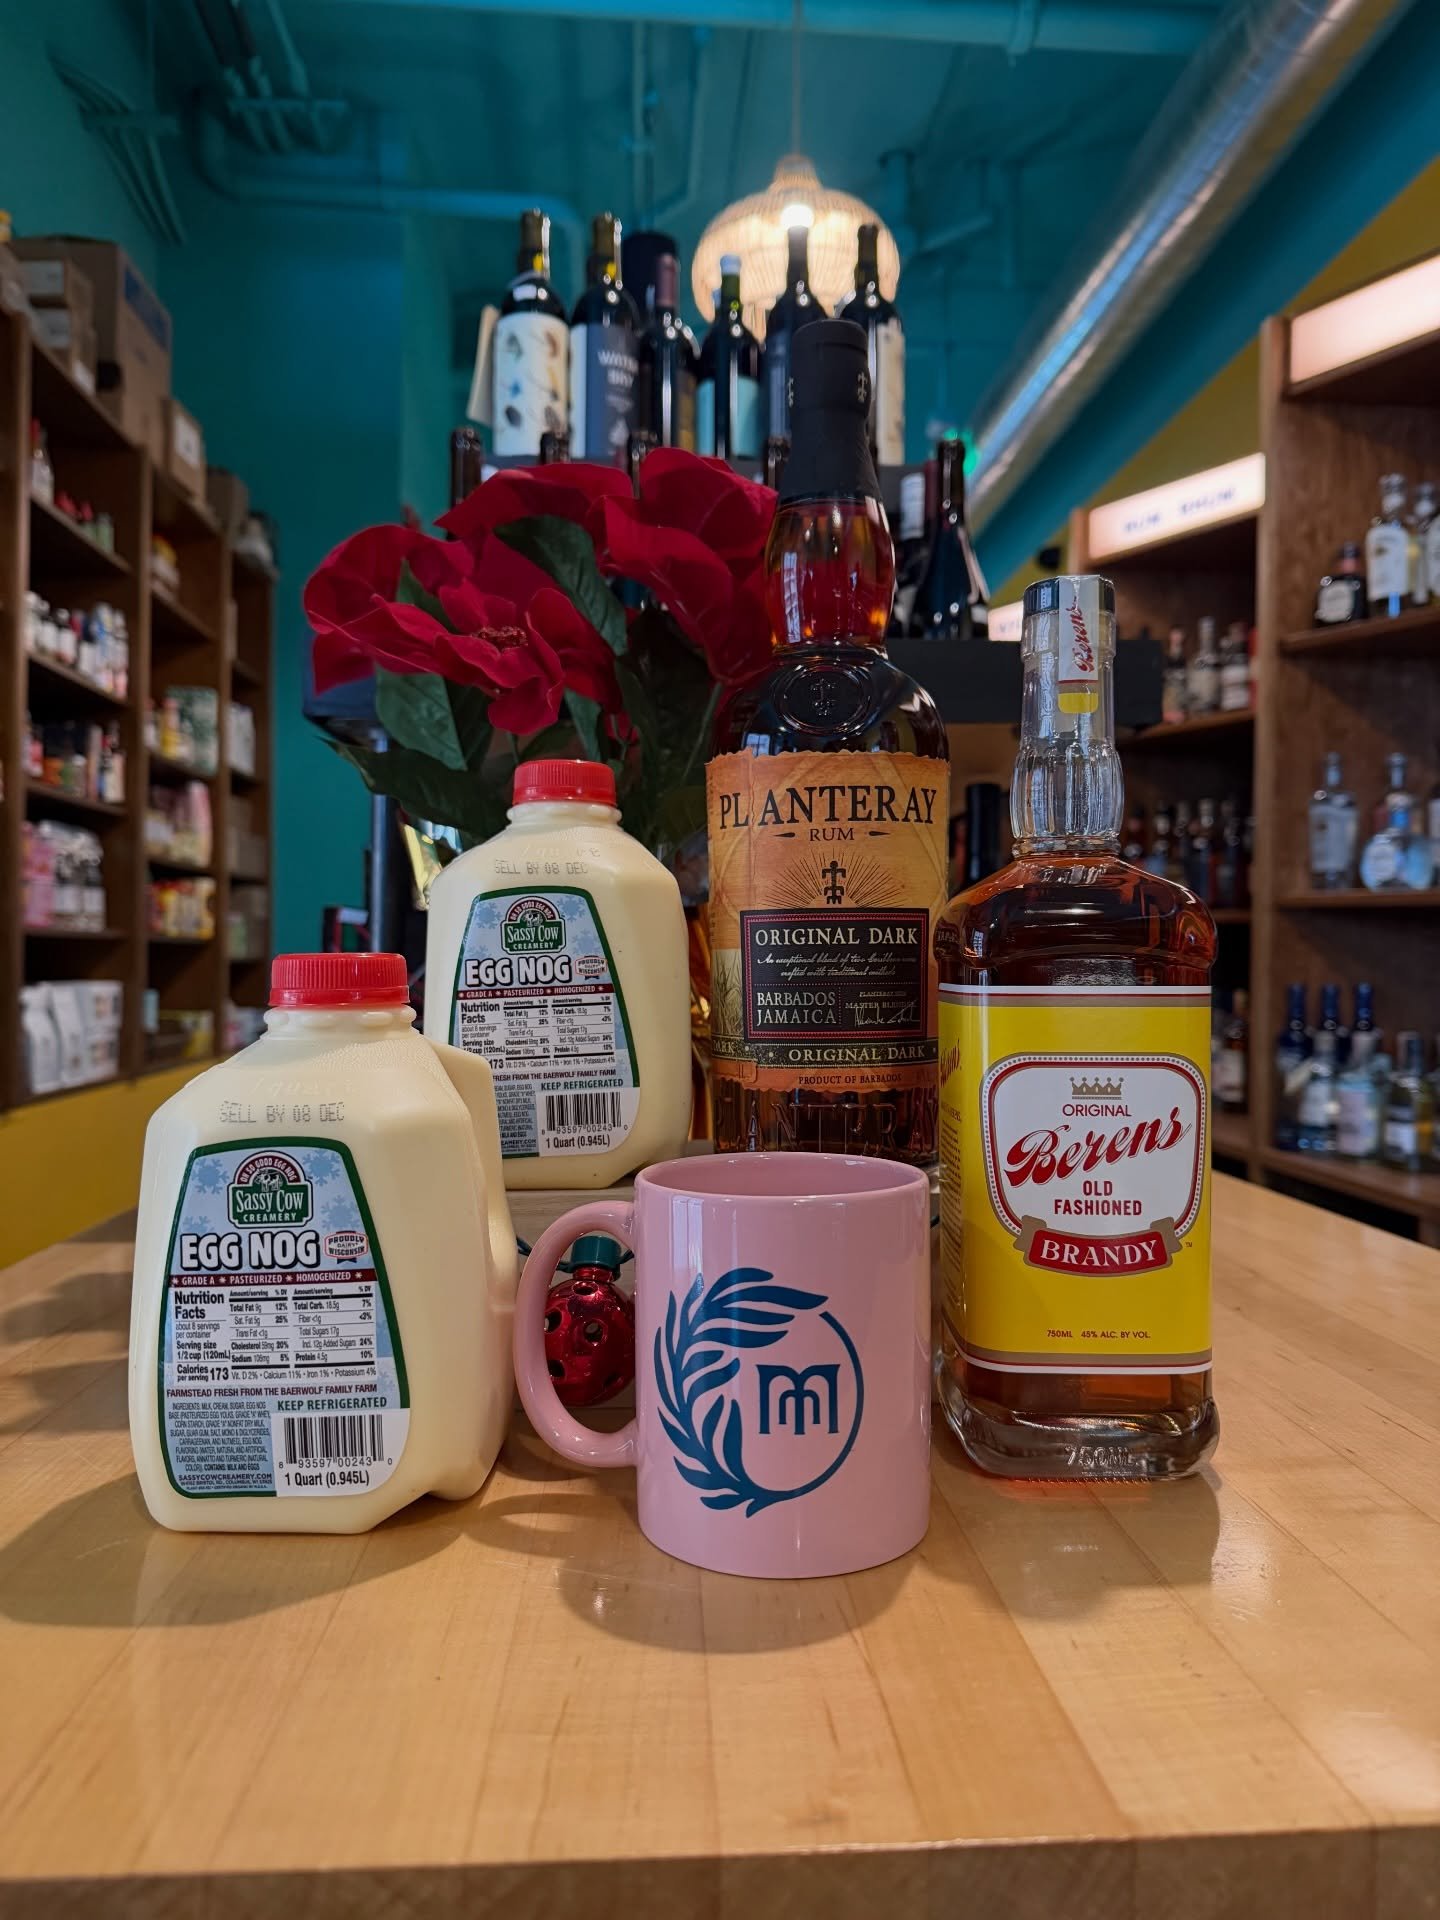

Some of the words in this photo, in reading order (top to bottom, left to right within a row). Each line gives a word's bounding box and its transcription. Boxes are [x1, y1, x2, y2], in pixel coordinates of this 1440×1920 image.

[720, 786, 937, 830] PLANTERAY
[810, 828, 854, 841] RUM
[527, 862, 539, 874] BY
[545, 862, 560, 874] 08
[566, 862, 588, 874] DEC
[507, 926, 535, 943] Sassy
[538, 925, 559, 941] Cow
[755, 928, 859, 945] ORIGINAL
[869, 927, 918, 944] DARK
[513, 942, 553, 950] CREAMERY
[466, 959, 512, 986] EGG
[518, 956, 571, 984] NOG
[554, 986, 595, 994] HOMOGENIZED
[757, 992, 836, 1006] BARBADOS
[461, 1002, 500, 1012] Nutrition
[462, 1014, 486, 1024] Facts
[757, 1009, 836, 1026] JAMAICA
[789, 1047, 881, 1062] ORIGINAL
[888, 1046, 924, 1059] DARK
[541, 1082, 561, 1091] KEEP
[564, 1079, 623, 1090] REFRIGERATED
[799, 1076, 841, 1085] PRODUCT
[845, 1075, 856, 1084] OF
[220, 1101, 256, 1122] SELL
[267, 1105, 285, 1122] BY
[293, 1105, 311, 1122] 08
[320, 1102, 344, 1121] DEC
[1062, 1104, 1132, 1117] ORIGINAL
[557, 1125, 581, 1134] 93597
[587, 1124, 612, 1132] 00243
[546, 1140, 550, 1149] 1
[554, 1137, 575, 1147] Quart
[578, 1134, 610, 1147] (0.945L)
[1004, 1106, 1192, 1188] Berens
[255, 1158, 272, 1167] GOOD
[274, 1159, 287, 1169] EGG
[284, 1166, 297, 1180] NOG
[1083, 1181, 1113, 1196] OLD
[236, 1190, 272, 1212] Sassy
[276, 1190, 304, 1212] Cow
[1054, 1200, 1142, 1216] FASHIONED
[243, 1213, 296, 1222] CREAMERY
[328, 1235, 364, 1244] PROUDLY
[181, 1234, 240, 1270] EGG
[250, 1231, 319, 1268] NOG
[329, 1246, 364, 1255] WISCONSIN
[1040, 1239, 1157, 1267] BRANDY
[182, 1277, 207, 1285] GRADE
[230, 1275, 282, 1284] PASTEURIZED
[296, 1272, 351, 1282] HOMOGENIZED
[175, 1291, 224, 1304] Nutrition
[230, 1304, 244, 1312] Total
[294, 1302, 308, 1310] Total
[362, 1299, 371, 1307] 7%
[175, 1306, 206, 1319] Facts
[245, 1316, 253, 1324] Fat
[299, 1315, 311, 1323] Fiber
[176, 1322, 190, 1330] about
[197, 1322, 220, 1332] servings
[236, 1329, 248, 1337] Trans
[250, 1328, 258, 1336] Fat
[299, 1328, 311, 1336] Total
[312, 1327, 328, 1337] Sugars
[330, 1327, 339, 1336] 17g
[186, 1330, 211, 1338] container
[1047, 1330, 1073, 1338] 750ML
[177, 1341, 201, 1350] Serving
[204, 1340, 216, 1349] size
[231, 1342, 261, 1350] Cholesterol
[276, 1341, 289, 1349] 20%
[340, 1340, 356, 1349] Sugars
[360, 1338, 372, 1346] 24%
[178, 1351, 188, 1360] 1/2
[189, 1352, 201, 1361] cup
[203, 1350, 230, 1360] (120mL)
[296, 1353, 316, 1361] Protein
[177, 1364, 208, 1374] Calories
[210, 1367, 229, 1380] 173
[248, 1371, 258, 1379] 2%
[263, 1371, 287, 1379] Calcium
[289, 1370, 301, 1378] 11%
[307, 1370, 318, 1378] Iron
[320, 1370, 329, 1378] 1%
[335, 1369, 365, 1377] Potassium
[366, 1367, 376, 1376] 4%
[188, 1374, 208, 1382] serving
[167, 1389, 212, 1398] FARMSTEAD
[214, 1388, 238, 1396] FRESH
[241, 1388, 262, 1396] FROM
[264, 1388, 279, 1396] THE
[281, 1386, 323, 1395] BAERWOLF
[325, 1385, 353, 1394] FAMILY
[355, 1384, 377, 1392] FARM
[278, 1400, 303, 1411] KEEP
[308, 1397, 387, 1410] REFRIGERATED
[298, 1458, 331, 1468] 93597
[338, 1457, 372, 1467] 00243
[285, 1472, 290, 1486] 1
[295, 1472, 322, 1486] Quart
[326, 1470, 369, 1488] (0.945L)
